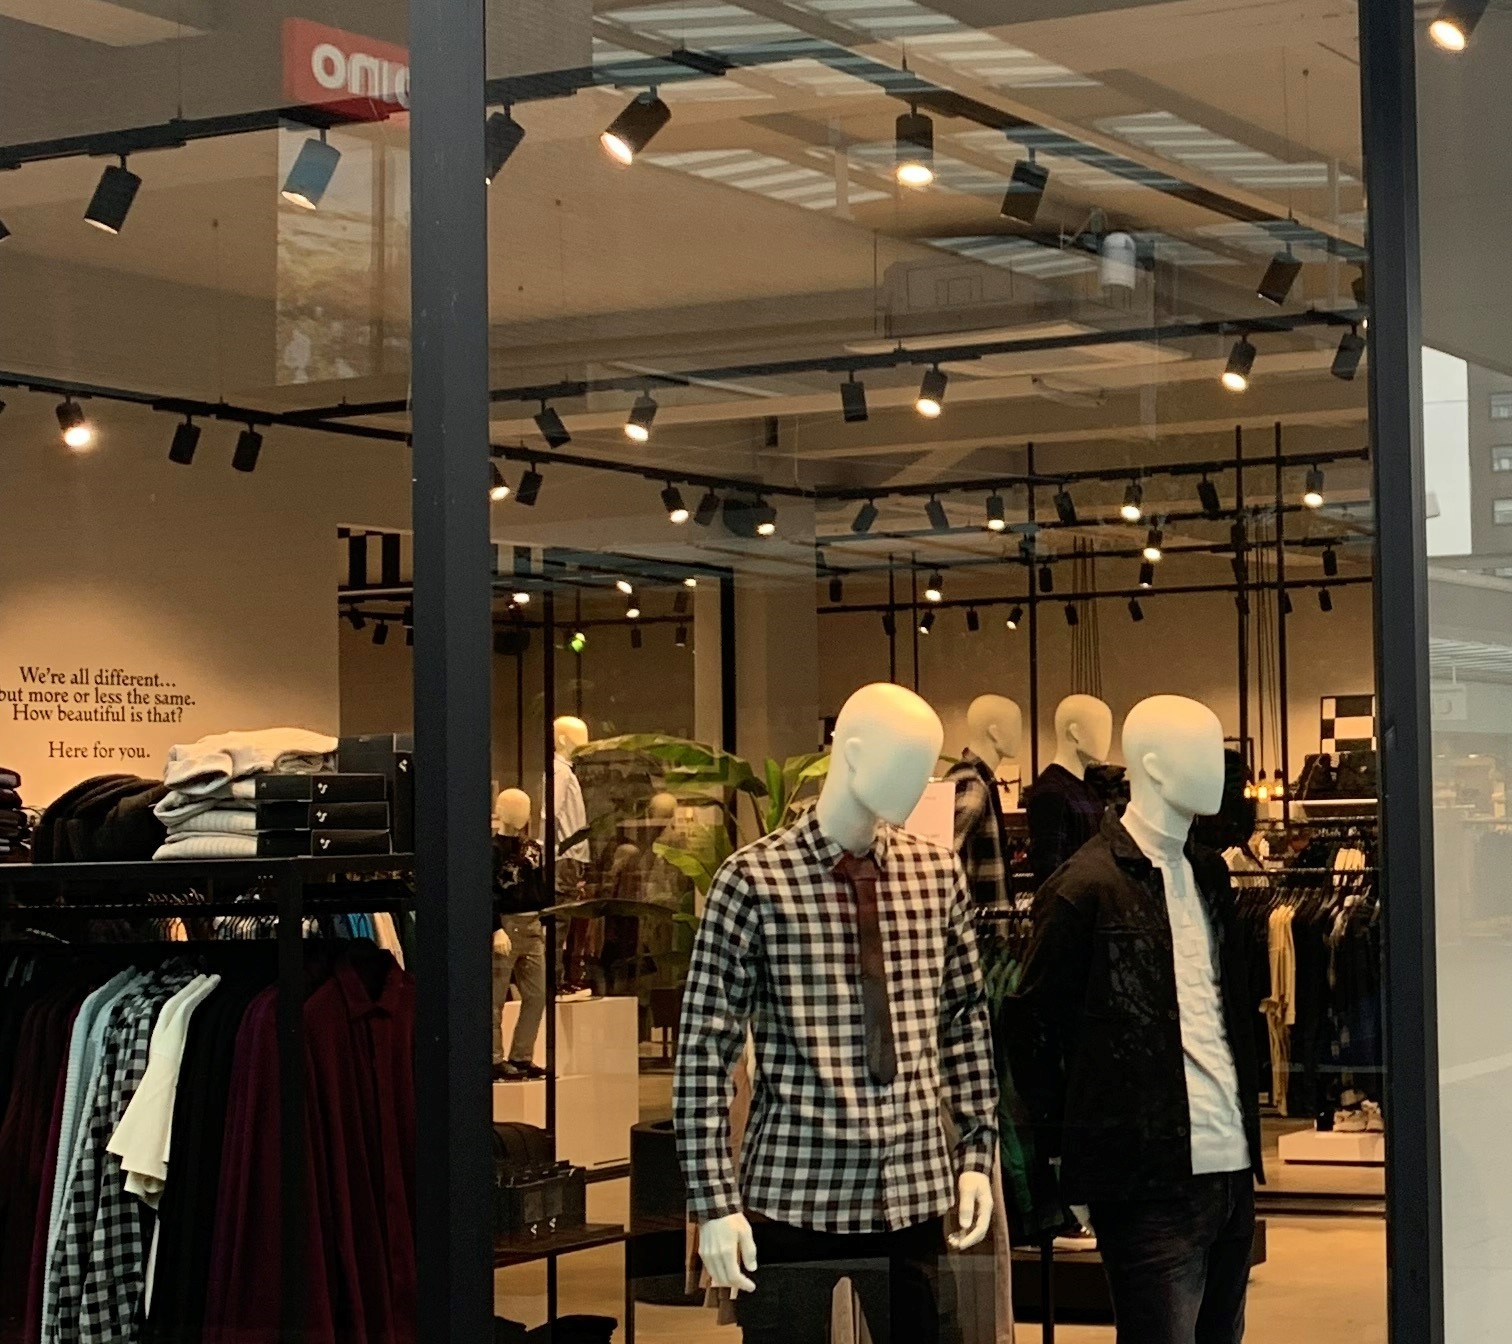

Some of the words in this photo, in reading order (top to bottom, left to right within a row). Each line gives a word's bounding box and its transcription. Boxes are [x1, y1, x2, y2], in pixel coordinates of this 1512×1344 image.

[19, 666, 66, 684] We're
[70, 668, 90, 686] all
[94, 668, 177, 688] different...
[28, 690, 69, 703] more
[73, 690, 90, 703] or
[95, 687, 123, 704] less
[127, 688, 150, 705] the
[154, 692, 196, 706] same.
[12, 703, 53, 721] How
[57, 705, 126, 723] beautiful
[130, 706, 143, 722] is
[147, 706, 183, 723] that?
[48, 741, 88, 758] Here
[93, 741, 115, 758] for
[118, 747, 151, 761] you.
